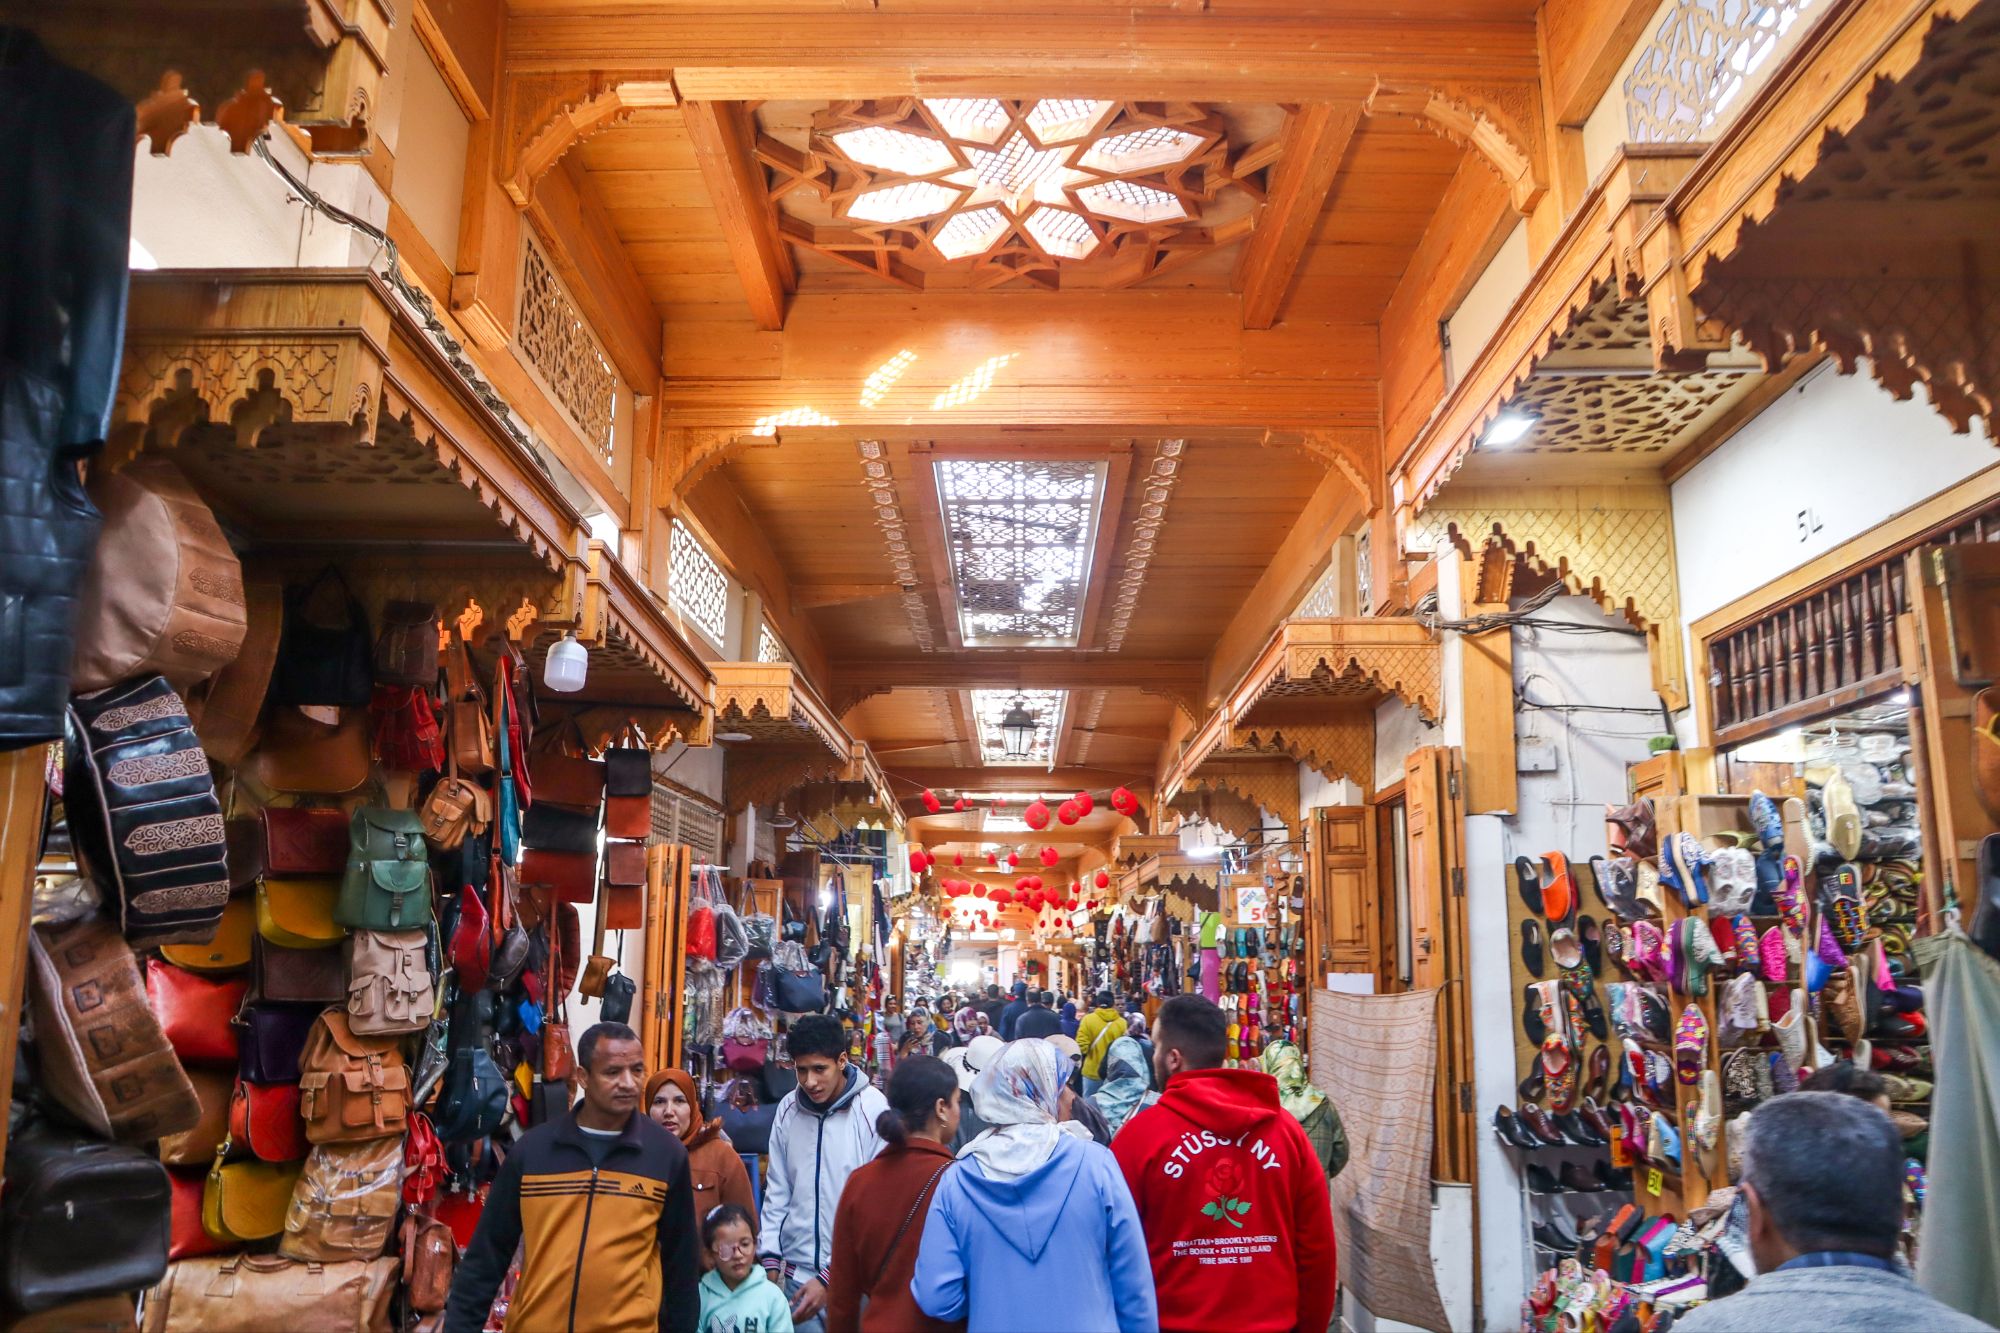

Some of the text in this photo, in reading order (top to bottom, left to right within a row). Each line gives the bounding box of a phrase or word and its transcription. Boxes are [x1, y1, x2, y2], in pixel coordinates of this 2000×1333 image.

[1251, 1139, 1281, 1170] NY
[1221, 1246, 1249, 1254] STATEN
[1217, 1256, 1238, 1264] SINCE
